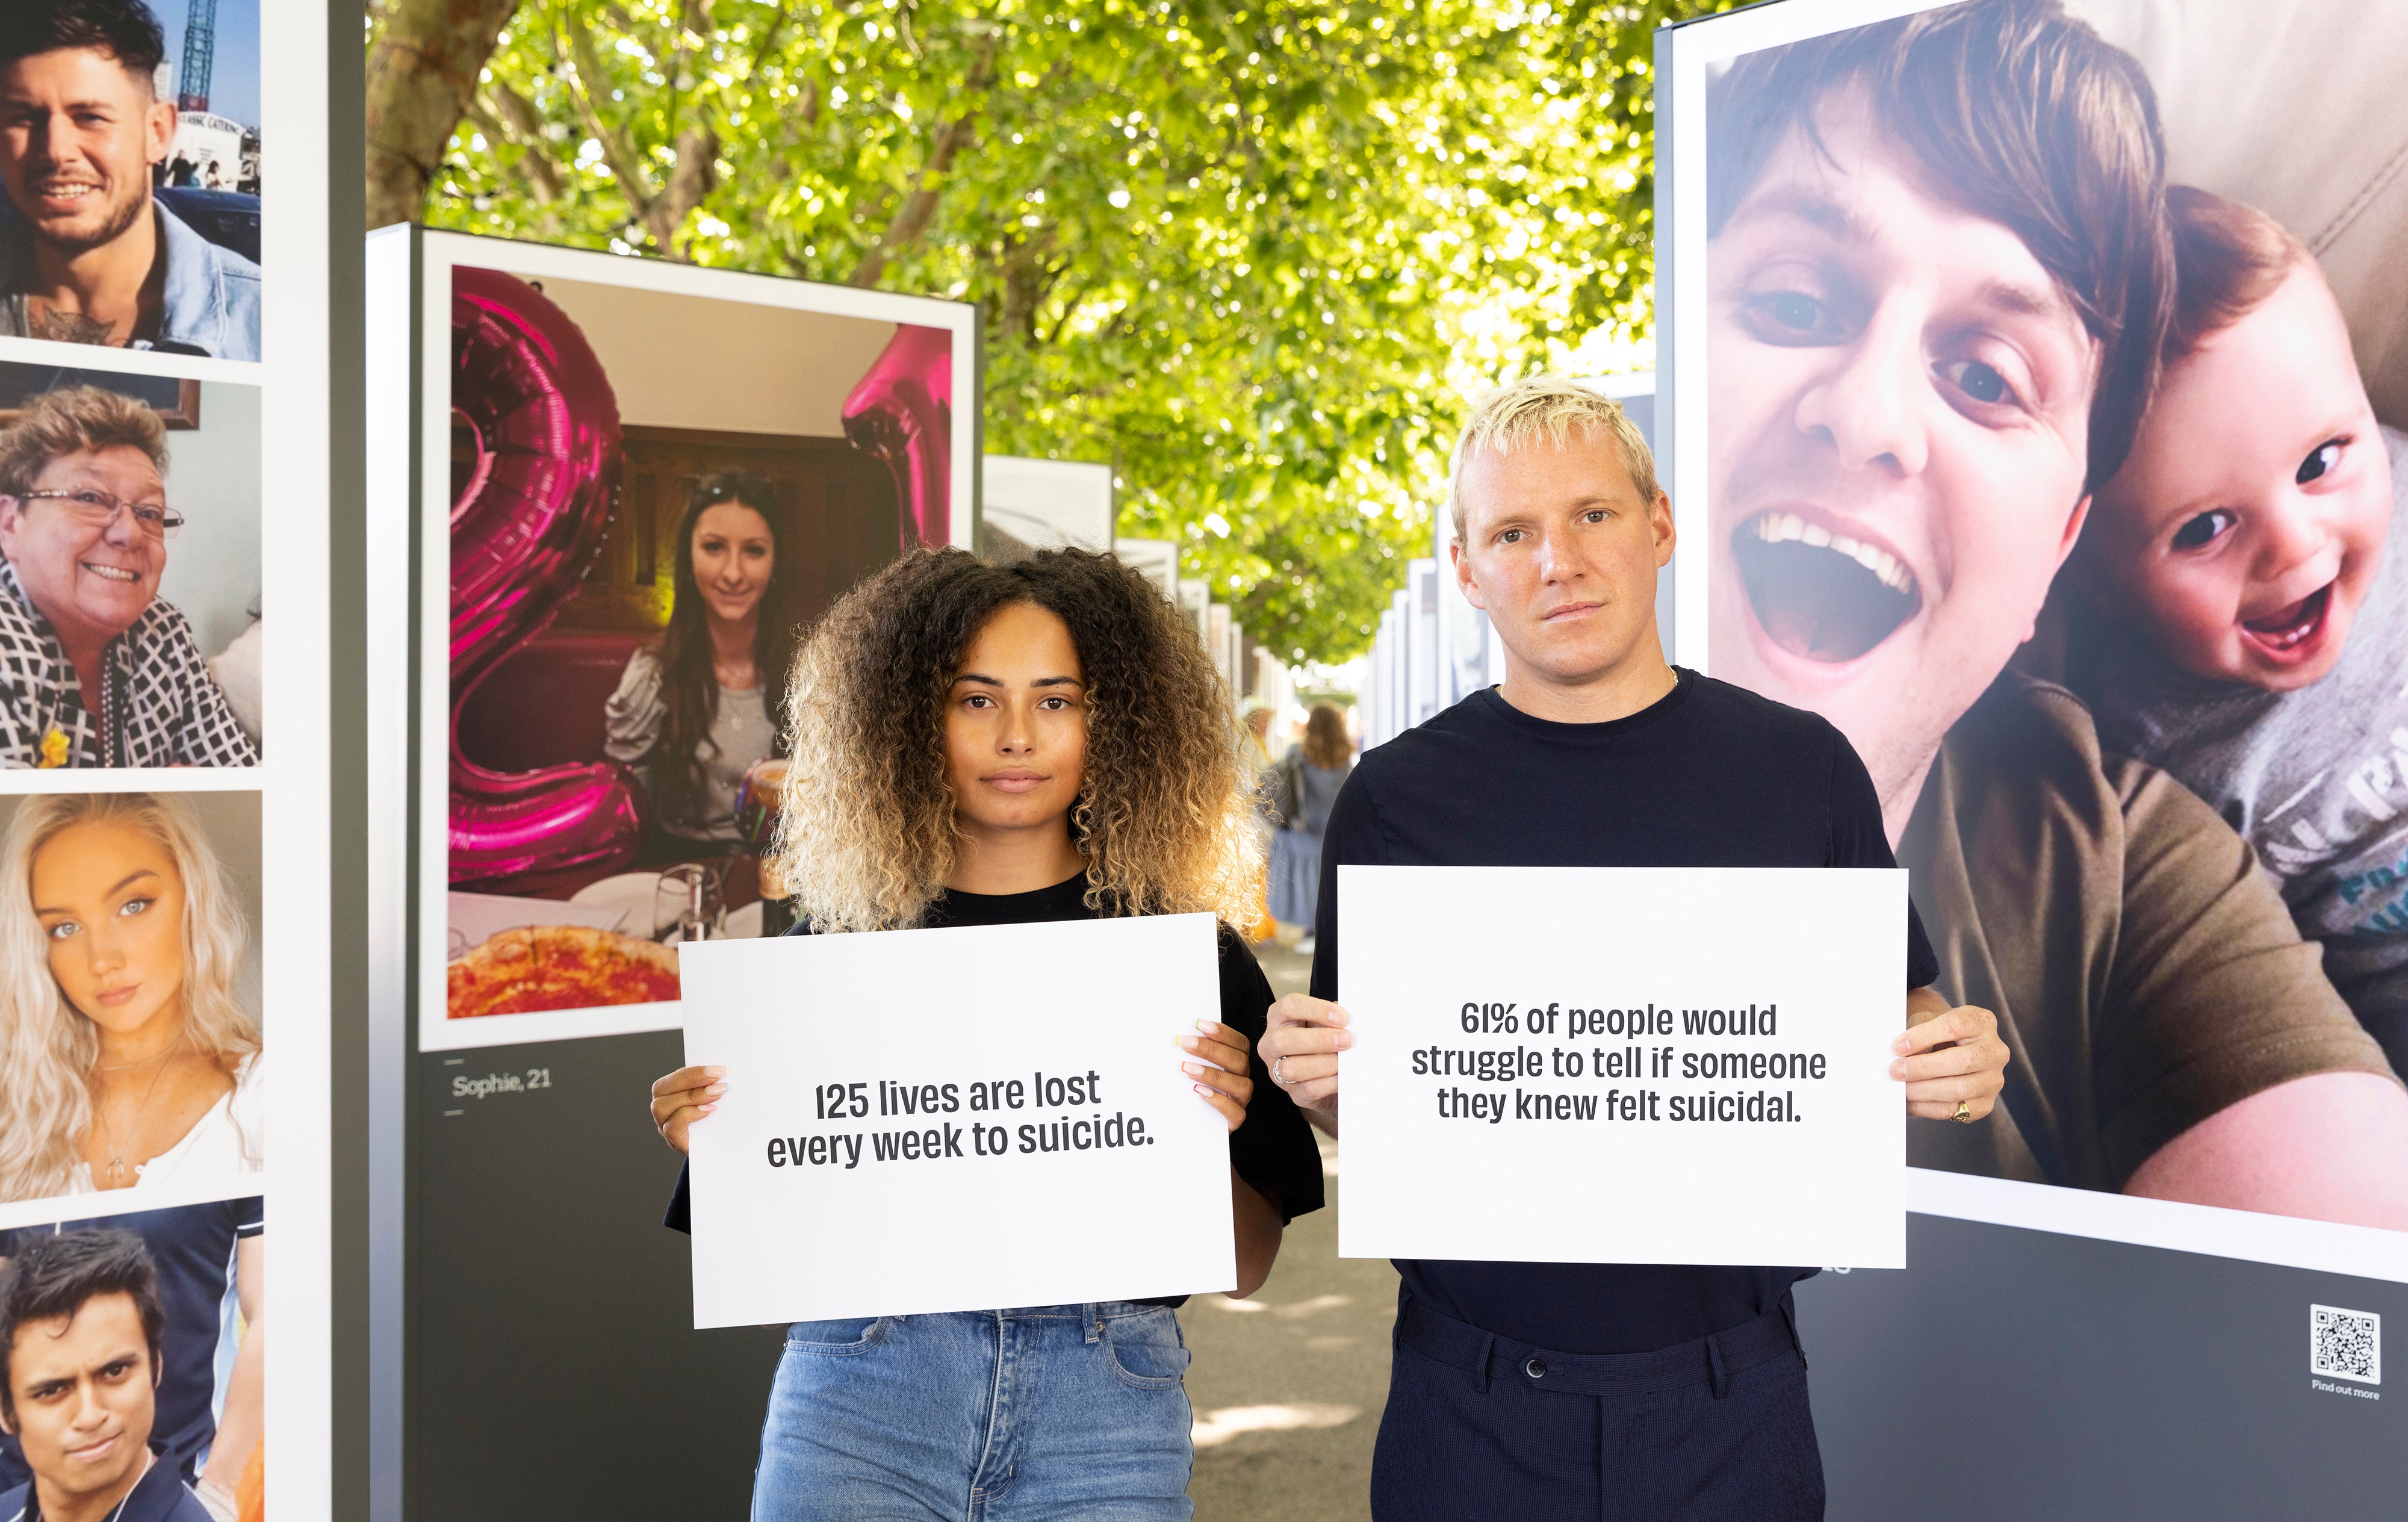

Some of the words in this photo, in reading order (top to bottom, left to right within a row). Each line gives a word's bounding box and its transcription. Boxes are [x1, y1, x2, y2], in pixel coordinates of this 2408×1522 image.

[1461, 1002, 1519, 1034] 61%
[1527, 1002, 1559, 1035] of
[1569, 1003, 1673, 1040] people
[1682, 1003, 1777, 1036] would
[1412, 1045, 1543, 1082] struggle
[1552, 1048, 1584, 1078] to
[1592, 1046, 1641, 1078] tell
[1652, 1046, 1674, 1078] if
[1682, 1052, 1826, 1079] someone
[452, 1072, 524, 1100] Sophie,
[527, 1069, 551, 1089] 21
[816, 1082, 869, 1120] 125
[879, 1080, 960, 1116] lives
[970, 1079, 1024, 1111] are
[1035, 1070, 1102, 1107] lost
[1437, 1087, 1507, 1124] they
[1516, 1088, 1598, 1121] knew
[1606, 1089, 1660, 1121] felt
[1669, 1090, 1802, 1122] suicidal.
[768, 1134, 863, 1169] every
[872, 1122, 964, 1161] week
[972, 1122, 1008, 1156] to
[1018, 1111, 1155, 1154] suicide.
[2312, 1379, 2335, 1392] Find
[2336, 1386, 2352, 1395] out
[2354, 1389, 2380, 1400] more
